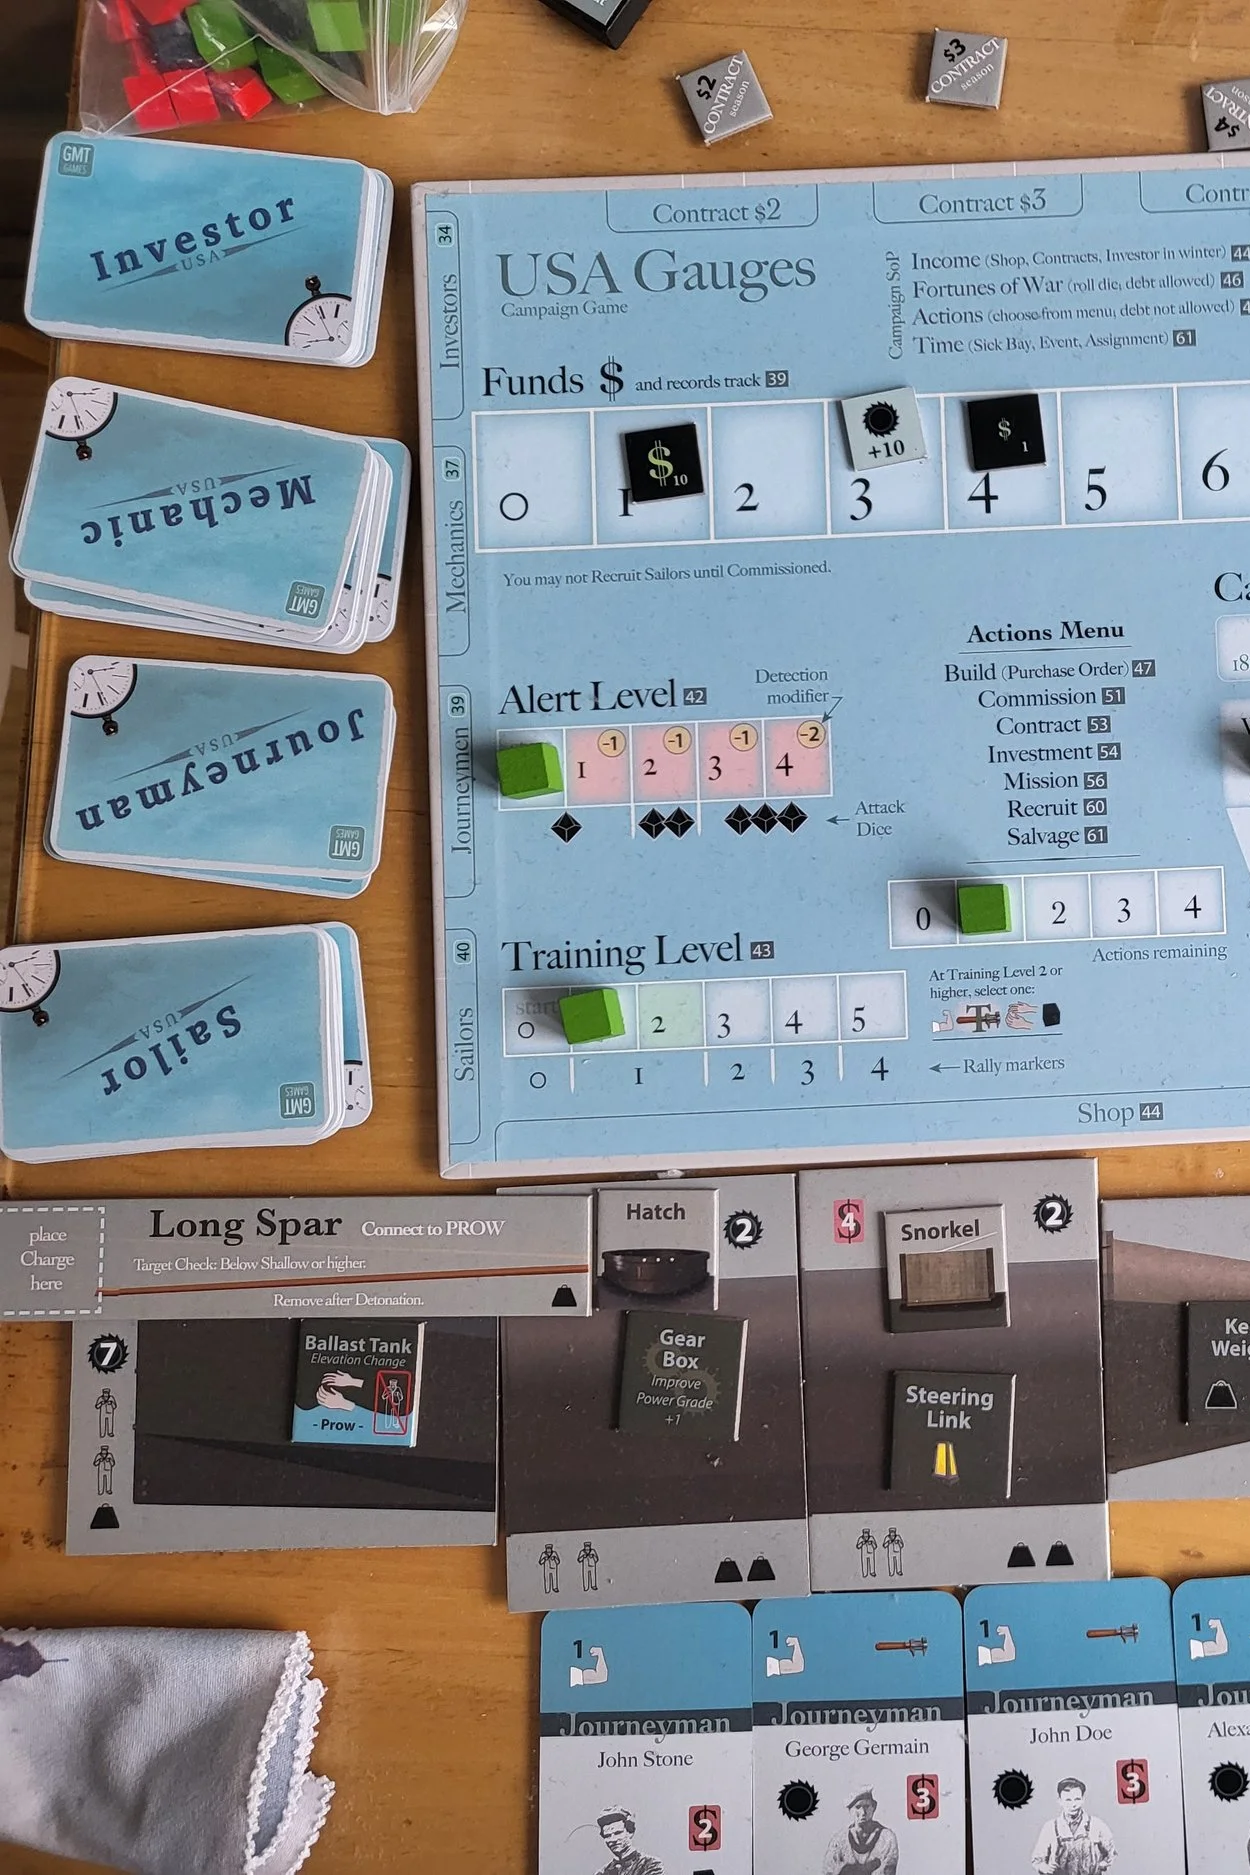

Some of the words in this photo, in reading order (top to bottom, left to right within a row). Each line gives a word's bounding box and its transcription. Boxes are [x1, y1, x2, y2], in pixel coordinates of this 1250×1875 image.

[943, 38, 966, 63] $3
[931, 38, 1000, 94] CONTRACT
[960, 63, 995, 91] season
[696, 74, 717, 99] $2
[703, 55, 745, 134] CONTRACT
[653, 204, 748, 224] Contract
[755, 198, 781, 227] $2
[919, 194, 1014, 214] Contract
[1020, 189, 1046, 213] $3
[89, 194, 297, 282] Investor
[181, 249, 221, 271] USA
[912, 253, 980, 269] Income
[496, 251, 622, 296] USA
[634, 249, 816, 302] Gauges
[913, 280, 995, 298] Fortunes
[1000, 278, 1020, 295] of
[1022, 277, 1064, 293] War
[1222, 273, 1243, 286] 46
[439, 274, 461, 369] Investors
[501, 302, 579, 320] Campaign
[584, 301, 628, 316] Game
[913, 307, 983, 325] Actions
[913, 337, 964, 354] Time
[968, 338, 1002, 353] (Sick
[1006, 337, 1036, 353] Bay,
[1040, 335, 1082, 349] Event,
[1086, 332, 1169, 349] Assignment)
[1175, 331, 1194, 345] 61
[481, 366, 584, 396] Funds
[600, 356, 623, 401] $
[635, 377, 662, 390] and
[666, 375, 720, 390] records
[724, 374, 760, 388] track
[767, 371, 787, 386] 39
[868, 440, 905, 458] +10
[849, 478, 873, 520] 3
[1085, 466, 1107, 511] 5
[80, 474, 317, 548] Mechanic
[446, 499, 466, 613] Mechanics
[503, 574, 531, 588] You
[534, 574, 562, 587] may
[566, 572, 588, 585] not
[591, 569, 641, 584] Recruit
[644, 567, 691, 581] Sailors
[694, 565, 724, 578] until
[727, 561, 831, 578] Commissioned.
[966, 623, 1052, 643] Actions
[1061, 621, 1125, 640] Menu
[755, 669, 828, 683] Detection
[944, 663, 996, 682] Build
[1002, 664, 1074, 681] (Purchase
[1079, 660, 1129, 678] Order)
[1134, 661, 1153, 676] 47
[499, 685, 581, 715] Alert
[590, 680, 676, 710] Level
[685, 689, 705, 703] 42
[767, 689, 830, 704] modifier
[978, 689, 1096, 708] Commission
[1105, 689, 1123, 702] 51
[988, 745, 1092, 764] Investment
[1100, 745, 1118, 759] 54
[75, 708, 366, 831] Journeyman
[855, 801, 905, 814] Attack
[856, 823, 892, 836] Dice
[1008, 828, 1079, 848] Salvage
[1087, 829, 1105, 843] 61
[502, 940, 645, 975] Training
[655, 934, 742, 966] Level
[752, 943, 772, 957] 43
[930, 987, 972, 1001] higher,
[974, 984, 1008, 996] select
[1009, 984, 1034, 994] one:
[101, 1004, 242, 1096] Sailor
[455, 1008, 475, 1081] Sailors
[962, 1060, 1002, 1075] Rally
[1006, 1056, 1065, 1072] markers
[1077, 1103, 1134, 1127] Shop
[1142, 1104, 1161, 1119] 44
[627, 1203, 686, 1220] Hatch
[29, 1228, 67, 1244] place
[150, 1209, 245, 1246] Long
[256, 1208, 342, 1245] Spar
[901, 1220, 980, 1242] Snorkel
[20, 1252, 75, 1269] Charge
[31, 1277, 63, 1291] here
[274, 1294, 323, 1308] Remove
[325, 1294, 353, 1307] after
[356, 1293, 423, 1307] Detonation.
[305, 1335, 365, 1353] Ballast
[369, 1337, 412, 1354] Tank
[660, 1329, 705, 1349] Gear
[663, 1351, 700, 1370] Box
[906, 1385, 994, 1410] Steering
[927, 1410, 971, 1430] Link
[1029, 1726, 1070, 1744] John
[1076, 1725, 1112, 1742] Doe
[785, 1740, 849, 1760] George
[854, 1739, 930, 1756] Germain
